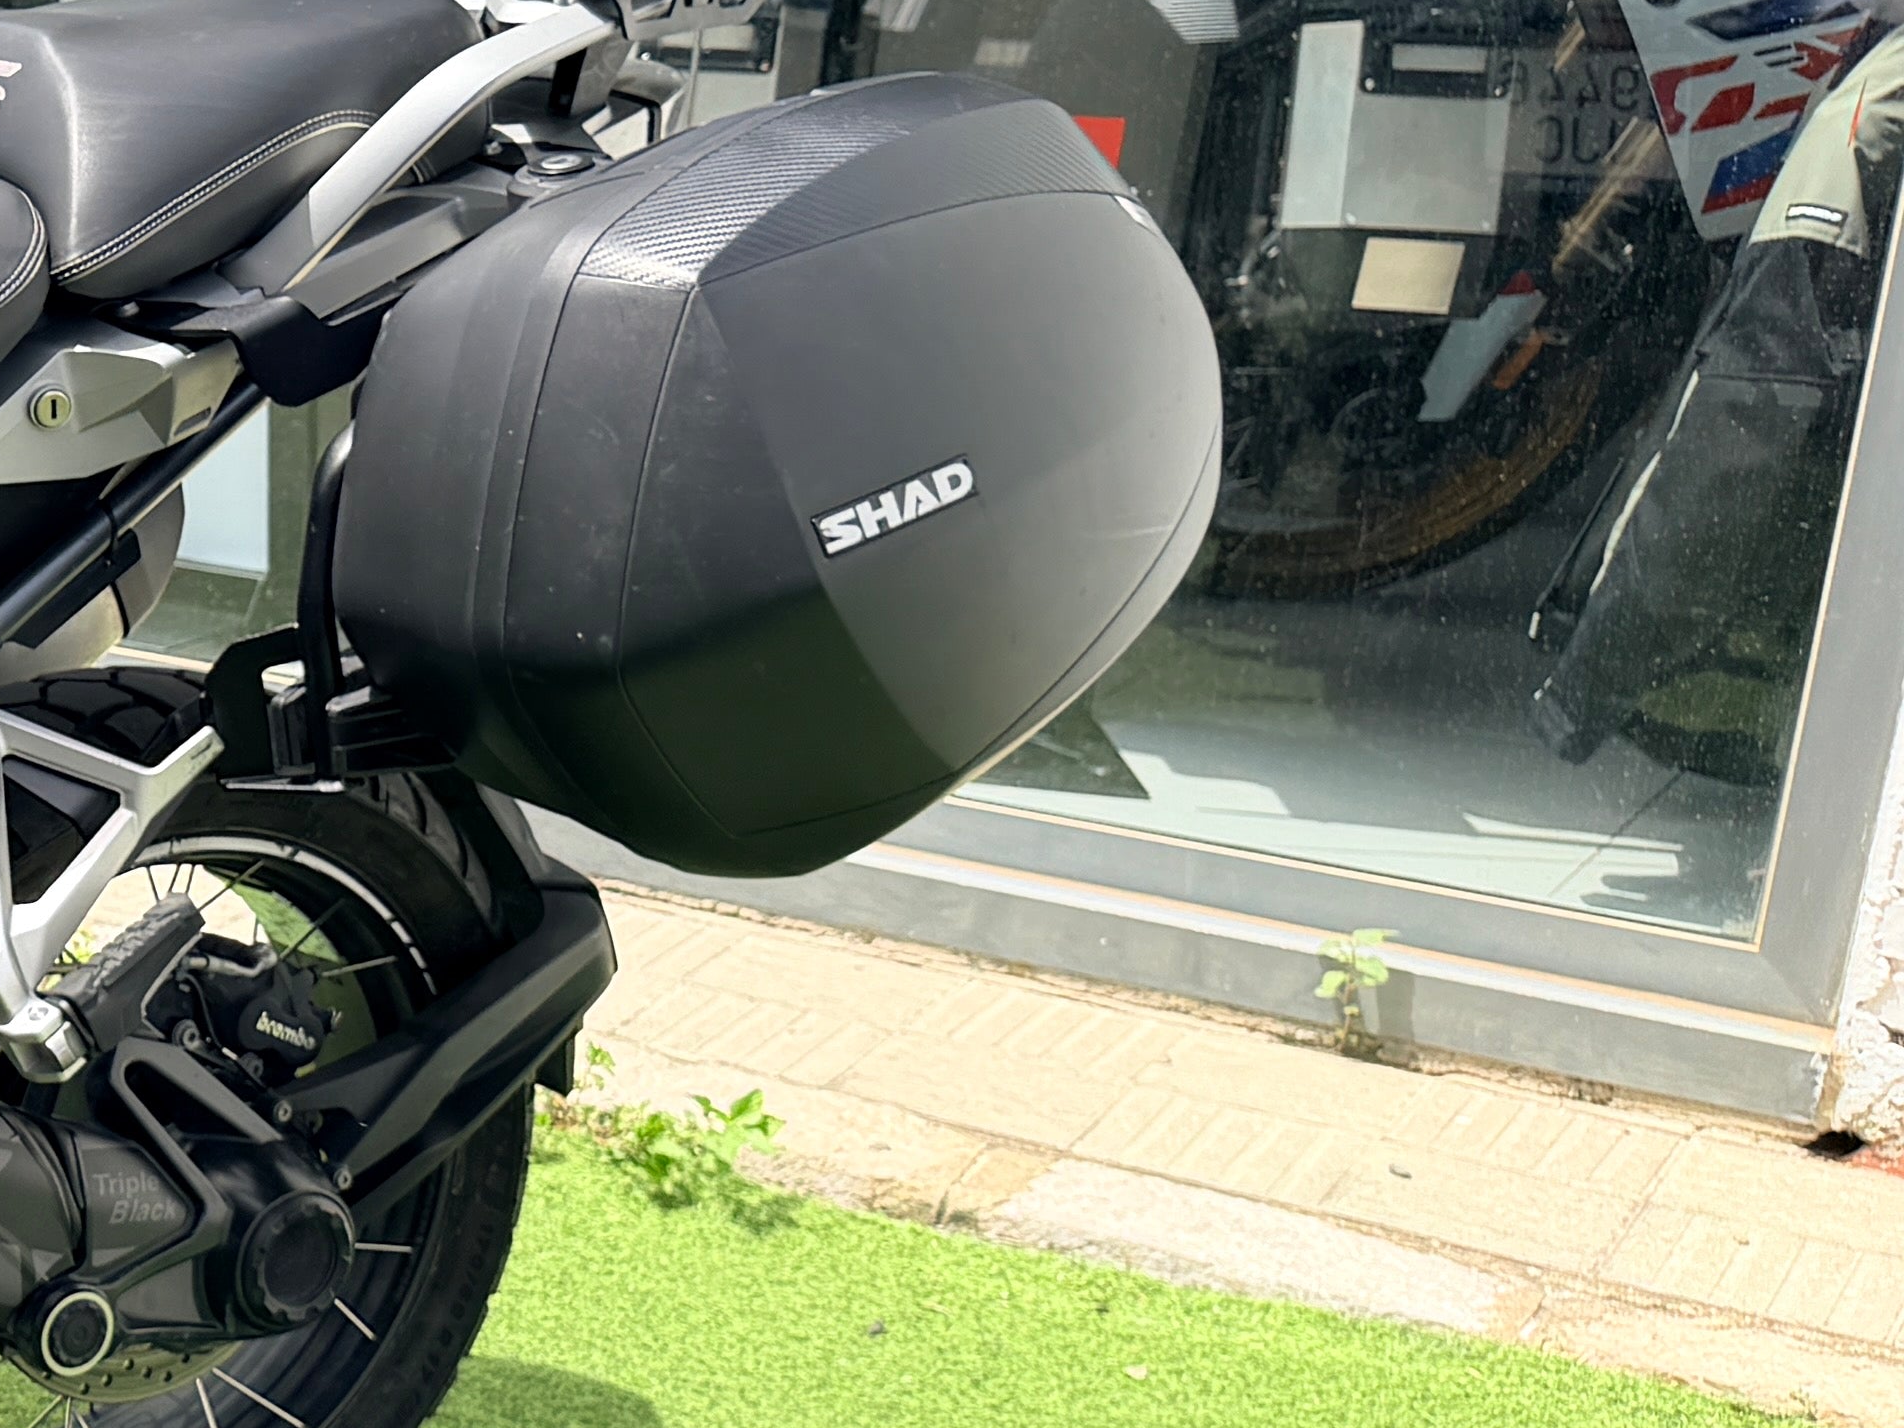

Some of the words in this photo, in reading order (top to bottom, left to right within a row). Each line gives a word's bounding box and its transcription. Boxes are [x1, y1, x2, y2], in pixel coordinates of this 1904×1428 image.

[819, 462, 974, 555] SHAD
[256, 1010, 317, 1050] brembo
[92, 1172, 160, 1199] Triple
[109, 1198, 177, 1225] Black
